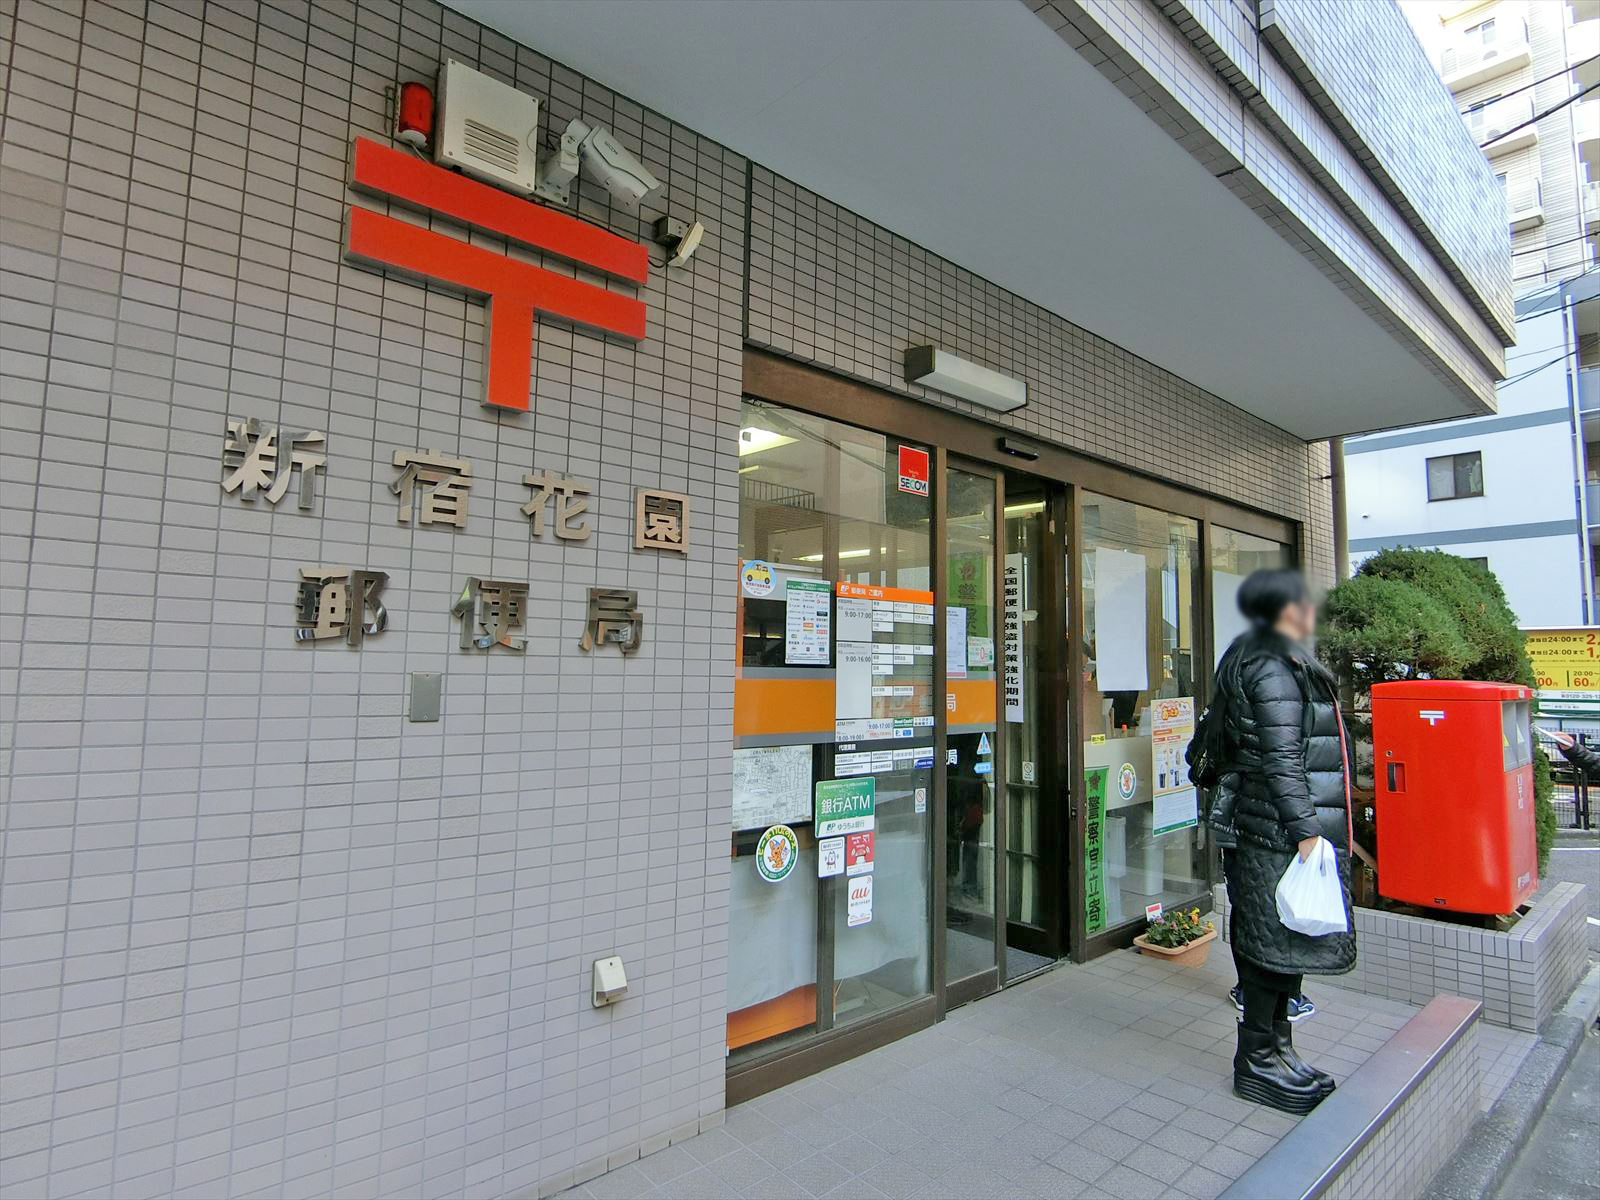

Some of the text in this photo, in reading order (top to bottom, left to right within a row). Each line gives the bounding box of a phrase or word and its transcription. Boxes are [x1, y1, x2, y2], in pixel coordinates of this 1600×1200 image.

[900, 478, 927, 492] SECOM
[294, 567, 644, 654] 郵便局
[821, 794, 871, 815] 銀行ATM
[851, 887, 870, 900] au
